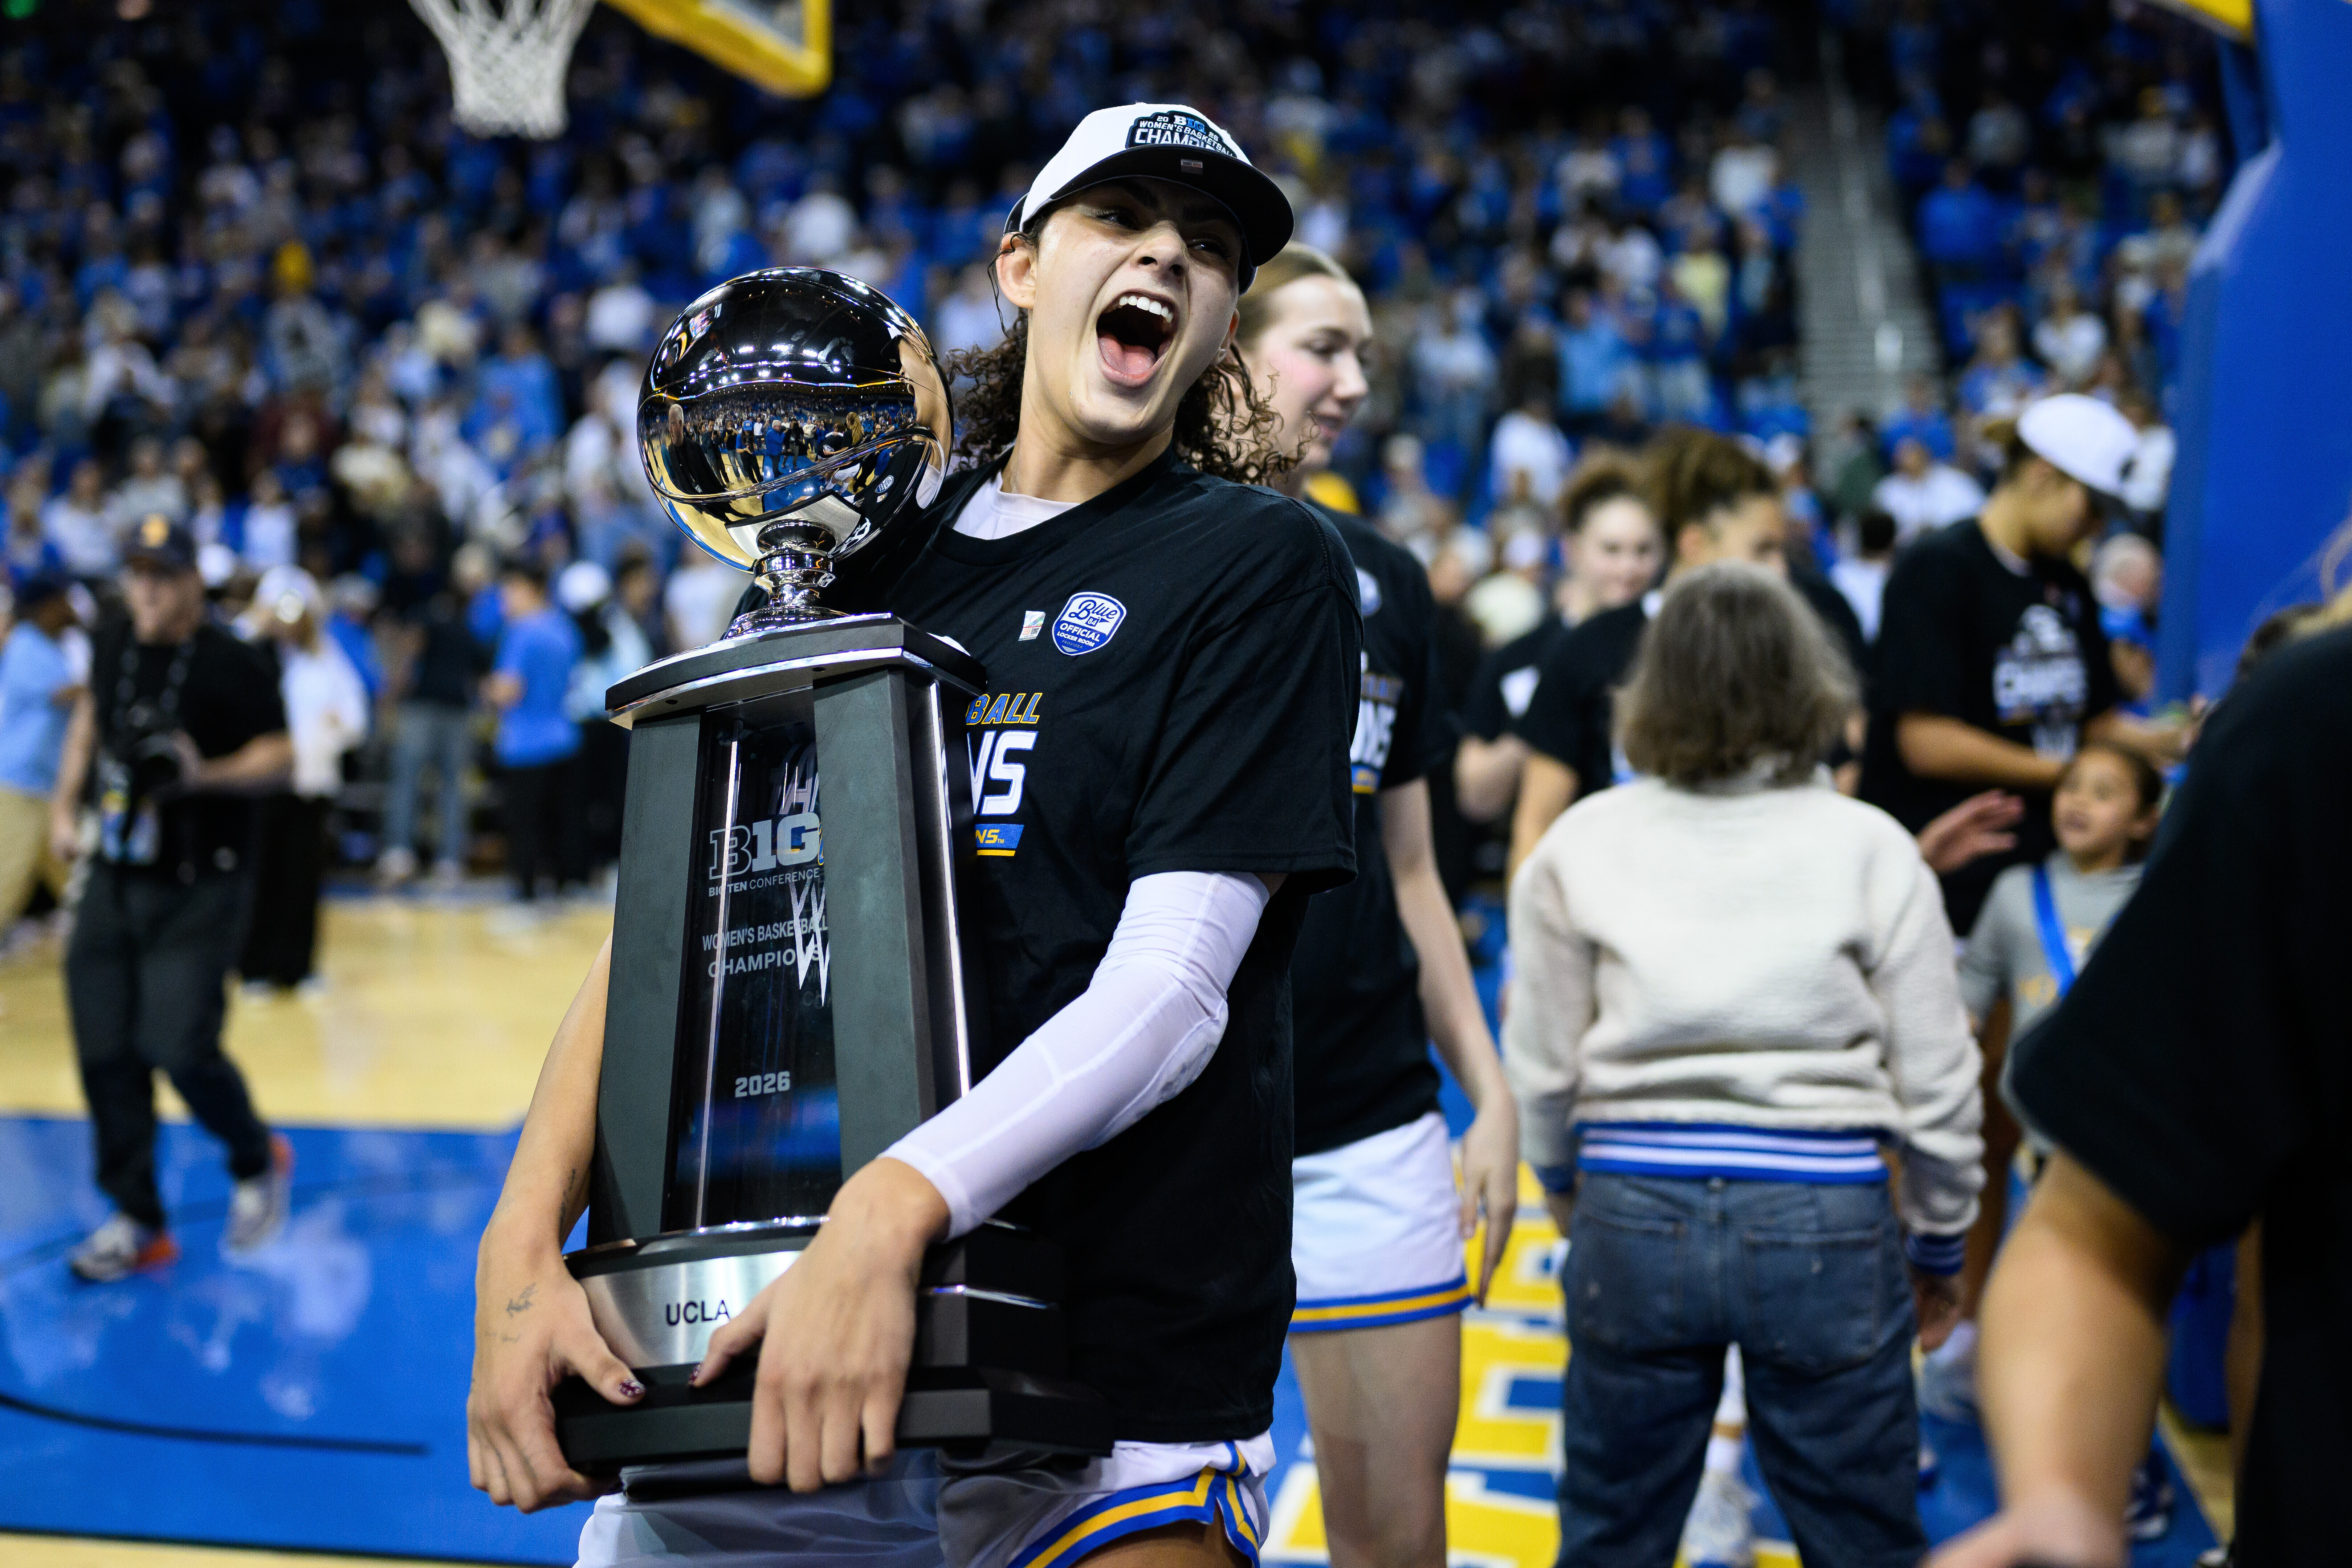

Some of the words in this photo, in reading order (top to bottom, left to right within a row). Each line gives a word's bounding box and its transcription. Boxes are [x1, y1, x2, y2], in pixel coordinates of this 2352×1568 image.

[1140, 121, 1183, 132] WOMEN'S
[1135, 129, 1215, 150] CHAMP
[1068, 600, 1117, 620] Blue
[1057, 631, 1077, 641] LOCKER
[1077, 637, 1095, 647] ROOM
[1060, 623, 1100, 642] OFFICIAL
[1062, 640, 1083, 648] PROVIDER
[727, 881, 747, 893] TEN
[750, 868, 820, 889] CONFERENCE
[758, 915, 828, 942] BASKEBAL
[708, 944, 820, 978] CHAMPIOS
[735, 1071, 790, 1097] 2026
[667, 1300, 731, 1326] UCLA
